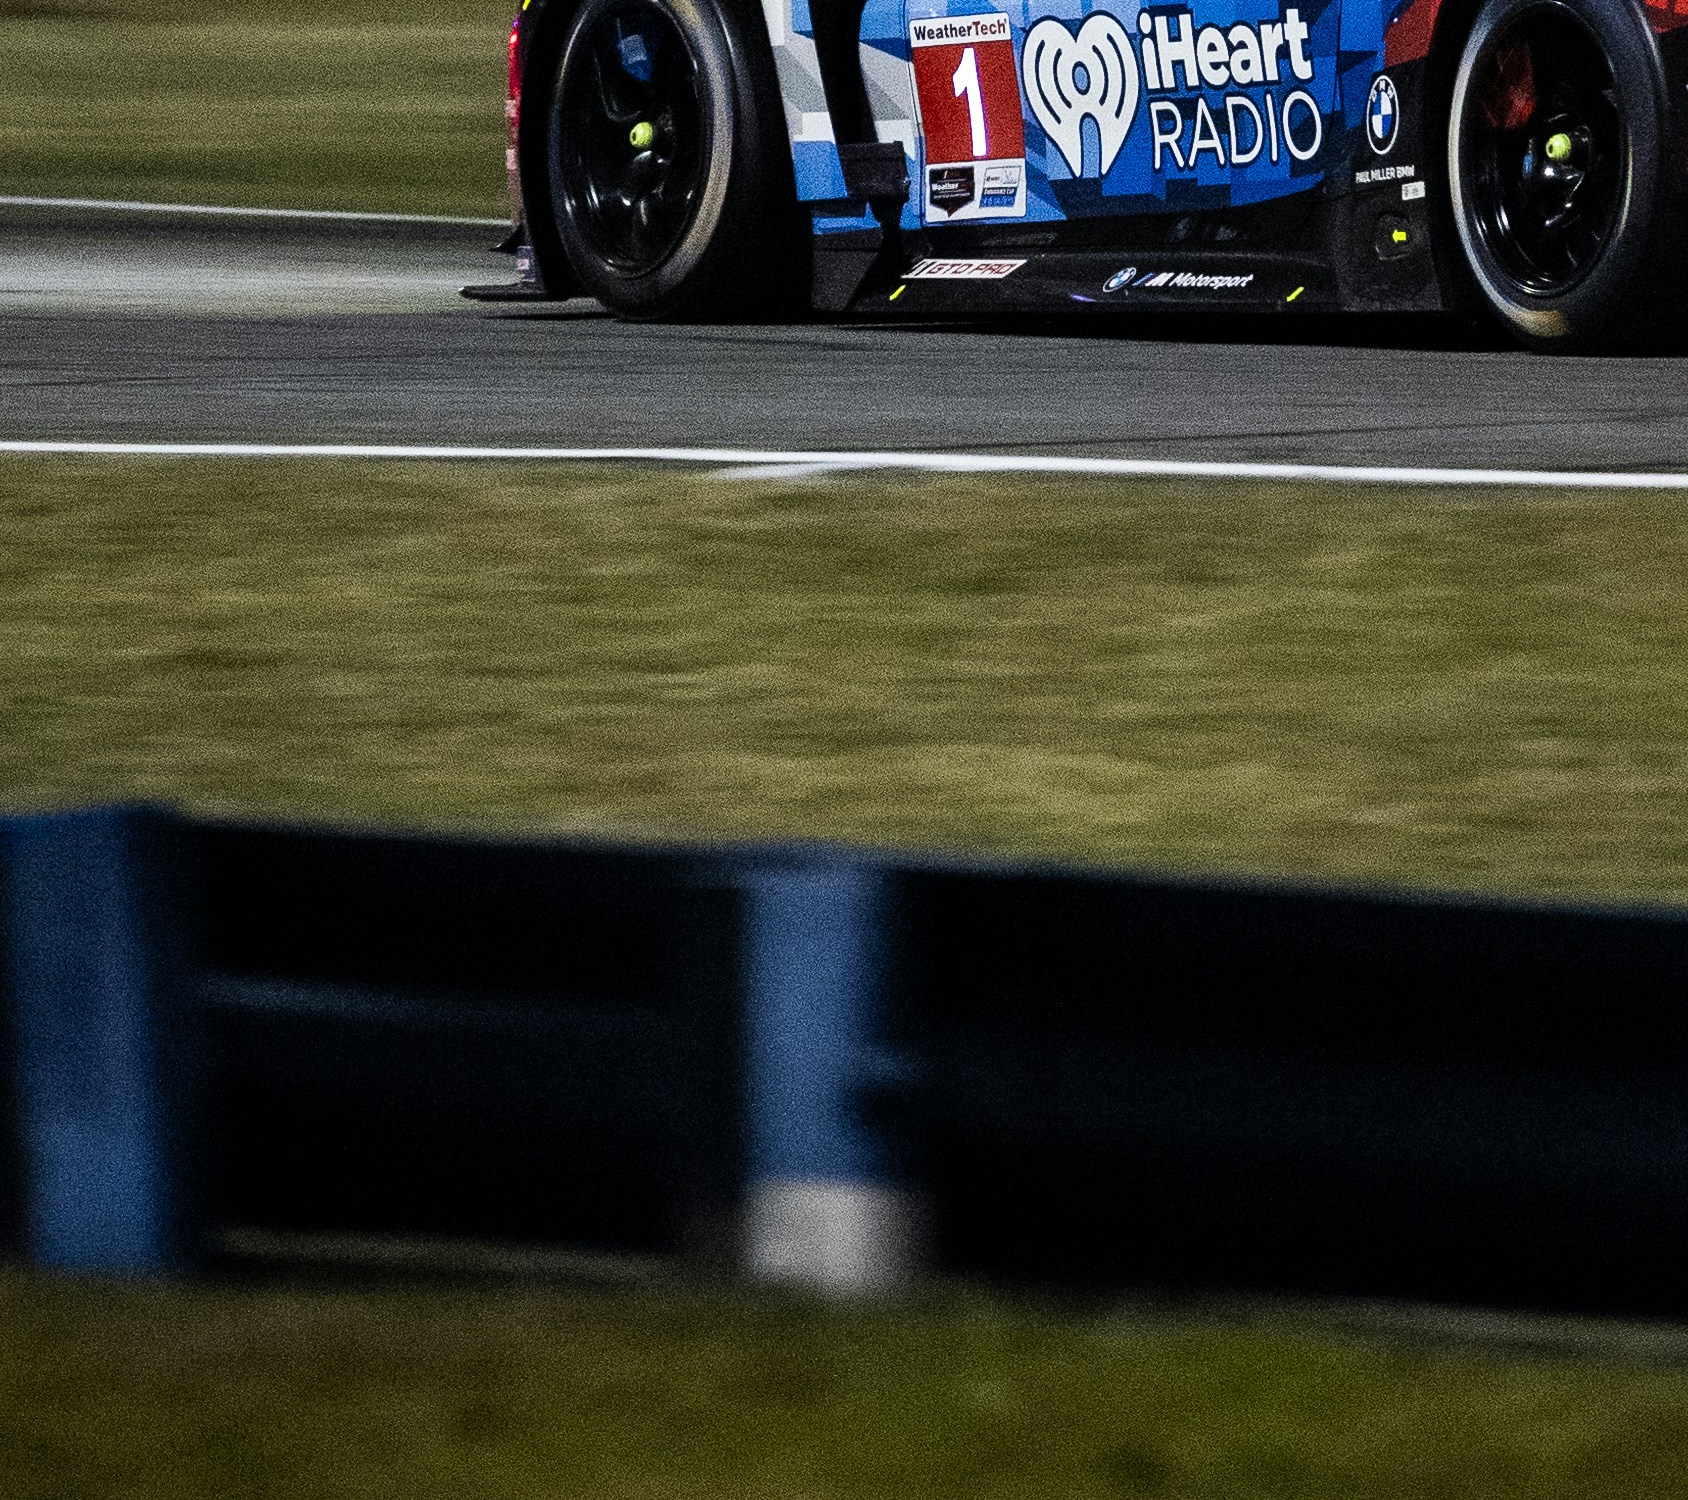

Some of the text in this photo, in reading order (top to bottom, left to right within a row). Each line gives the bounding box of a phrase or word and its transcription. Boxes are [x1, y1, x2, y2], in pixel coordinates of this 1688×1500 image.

[913, 19, 1008, 41] WeatherTech
[1140, 8, 1314, 91] iHeart
[952, 46, 989, 158] 1
[1150, 90, 1323, 170] RADIO
[925, 263, 1018, 275] GTD PRO
[1168, 272, 1254, 290] Motorsport
